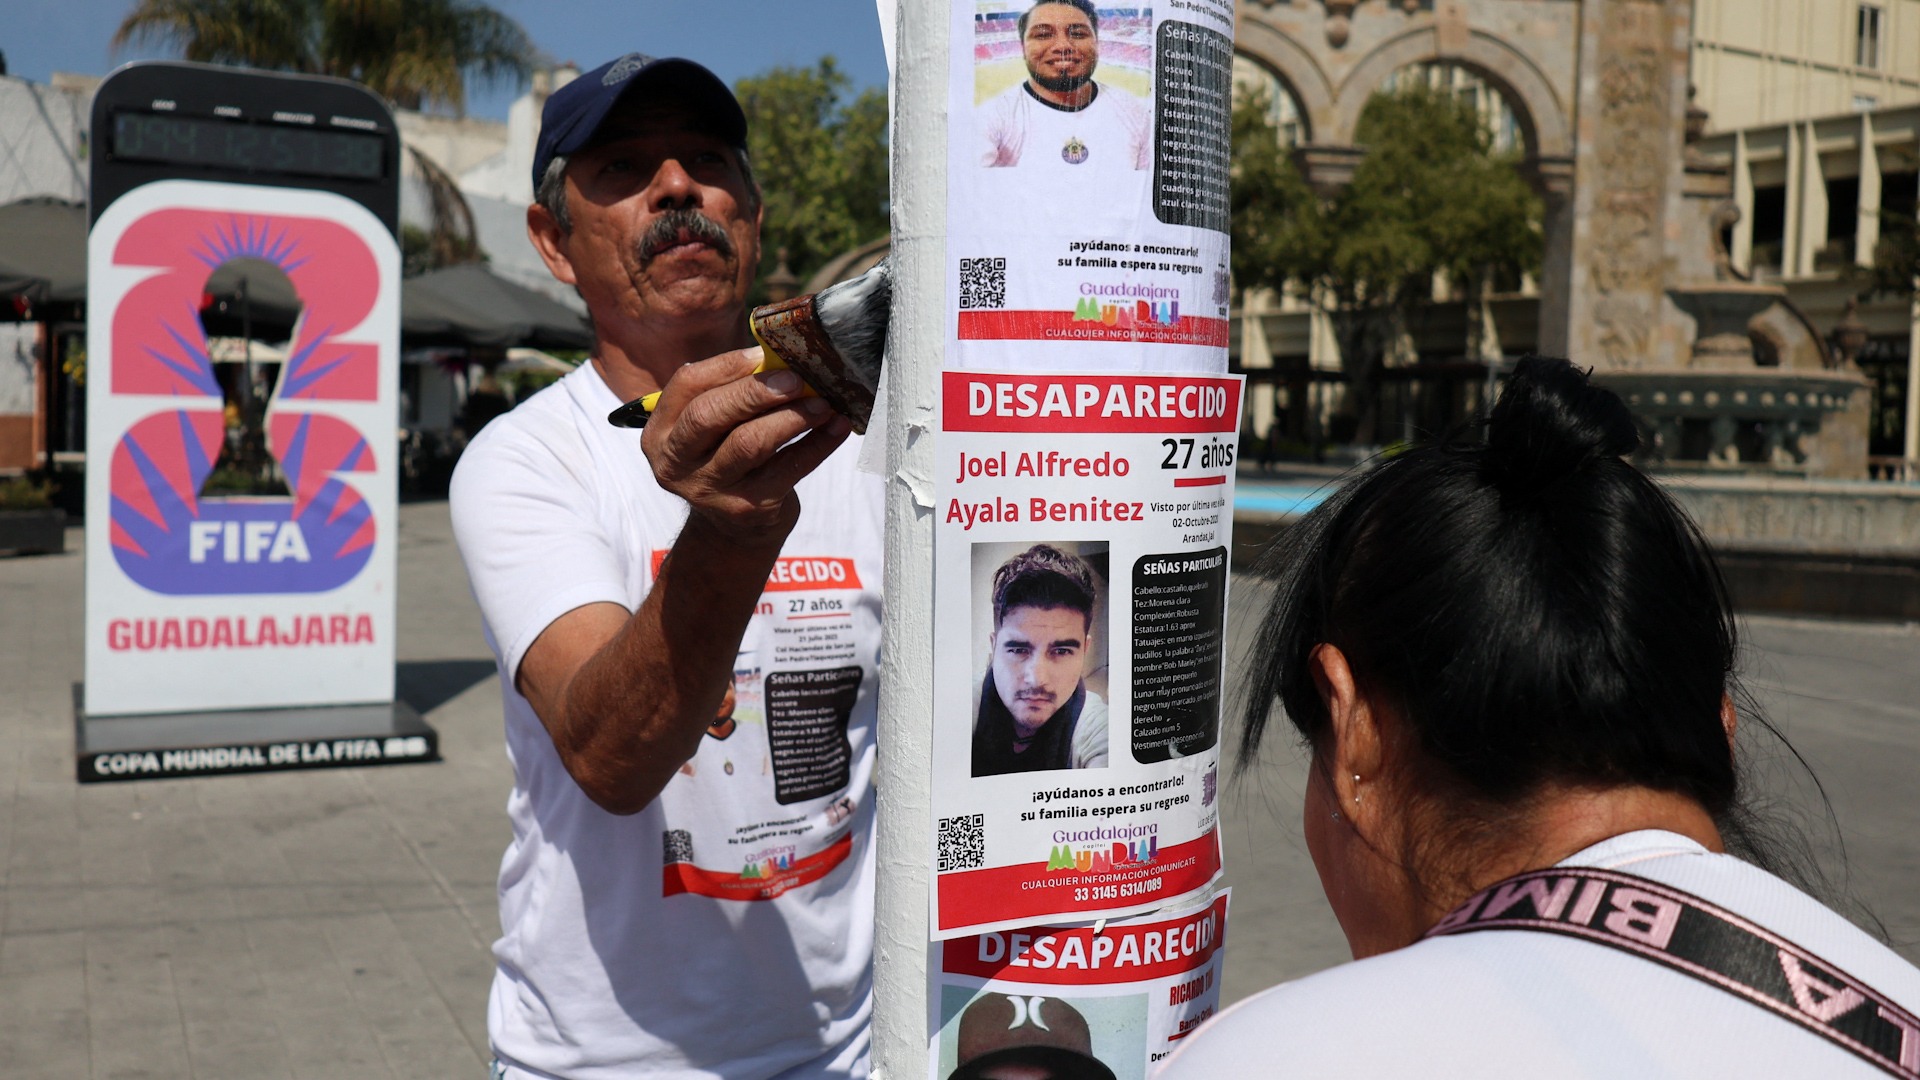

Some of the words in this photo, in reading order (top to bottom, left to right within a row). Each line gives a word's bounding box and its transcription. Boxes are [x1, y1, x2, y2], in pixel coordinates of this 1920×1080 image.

[1166, 25, 1200, 43] Señas
[1165, 49, 1195, 61] Cabello
[1164, 65, 1193, 76] oscuro
[1164, 79, 1179, 88] Tez
[1163, 124, 1187, 134] Lunar
[1162, 169, 1187, 180] negro
[1162, 183, 1194, 195] cuadros
[1161, 198, 1179, 207] azul
[1134, 244, 1141, 252] a
[1058, 258, 1072, 266] su
[1075, 256, 1117, 268] familia
[1120, 260, 1156, 271] espera
[1159, 262, 1170, 271] su
[1172, 263, 1203, 275] regreso
[1079, 281, 1180, 302] Guadalajara
[1046, 328, 1104, 339] CUALQUIER
[1107, 328, 1170, 341] INFORMACIÓN
[968, 381, 1227, 418] DESAPARECIDO
[1161, 438, 1195, 470] 27
[1201, 437, 1234, 468] años
[956, 451, 1006, 483] Joel
[1015, 451, 1130, 478] Alfredo
[946, 497, 1019, 530] Ayala
[1029, 497, 1144, 522] Benitez
[1150, 502, 1174, 512] Visto
[1176, 503, 1191, 514] por
[1192, 501, 1210, 511] última
[189, 520, 312, 564] FIFA
[1143, 559, 1180, 575] SEÑAS
[789, 599, 804, 613] 27
[811, 598, 843, 611] años
[107, 613, 375, 652] GUADALAJARA
[1134, 650, 1163, 660] nudillos
[1172, 646, 1195, 658] palabra
[771, 673, 805, 684] Señas
[771, 689, 799, 698] Cabello
[1134, 690, 1155, 699] Lunar
[1134, 714, 1163, 724] derecho
[1133, 727, 1161, 738] Calzado
[94, 752, 161, 775] COPA
[162, 746, 267, 771] MUNDIAL
[268, 743, 299, 764] DE
[300, 741, 332, 762] LA
[333, 738, 380, 761] FIFA
[1032, 785, 1104, 803] ¡ayúdanos
[1107, 787, 1116, 797] a
[1119, 775, 1184, 797] encontrarlo!
[1020, 810, 1035, 822] su
[1039, 806, 1088, 820] familia
[1091, 803, 1137, 819] espera
[1139, 801, 1152, 813] su
[1154, 793, 1190, 812] regreso
[1053, 822, 1158, 844] Guadalajara
[1046, 836, 1159, 873] MUNDIAL
[1021, 876, 1079, 891] CUALQUIER
[1081, 868, 1149, 884] INFORMACIÓN
[1150, 857, 1196, 876] COMUNÍCATE
[1074, 888, 1089, 902] 33
[1092, 887, 1118, 901] 3145
[1120, 877, 1162, 898] 6314/089
[978, 909, 1216, 970] DESAPARECIDO
